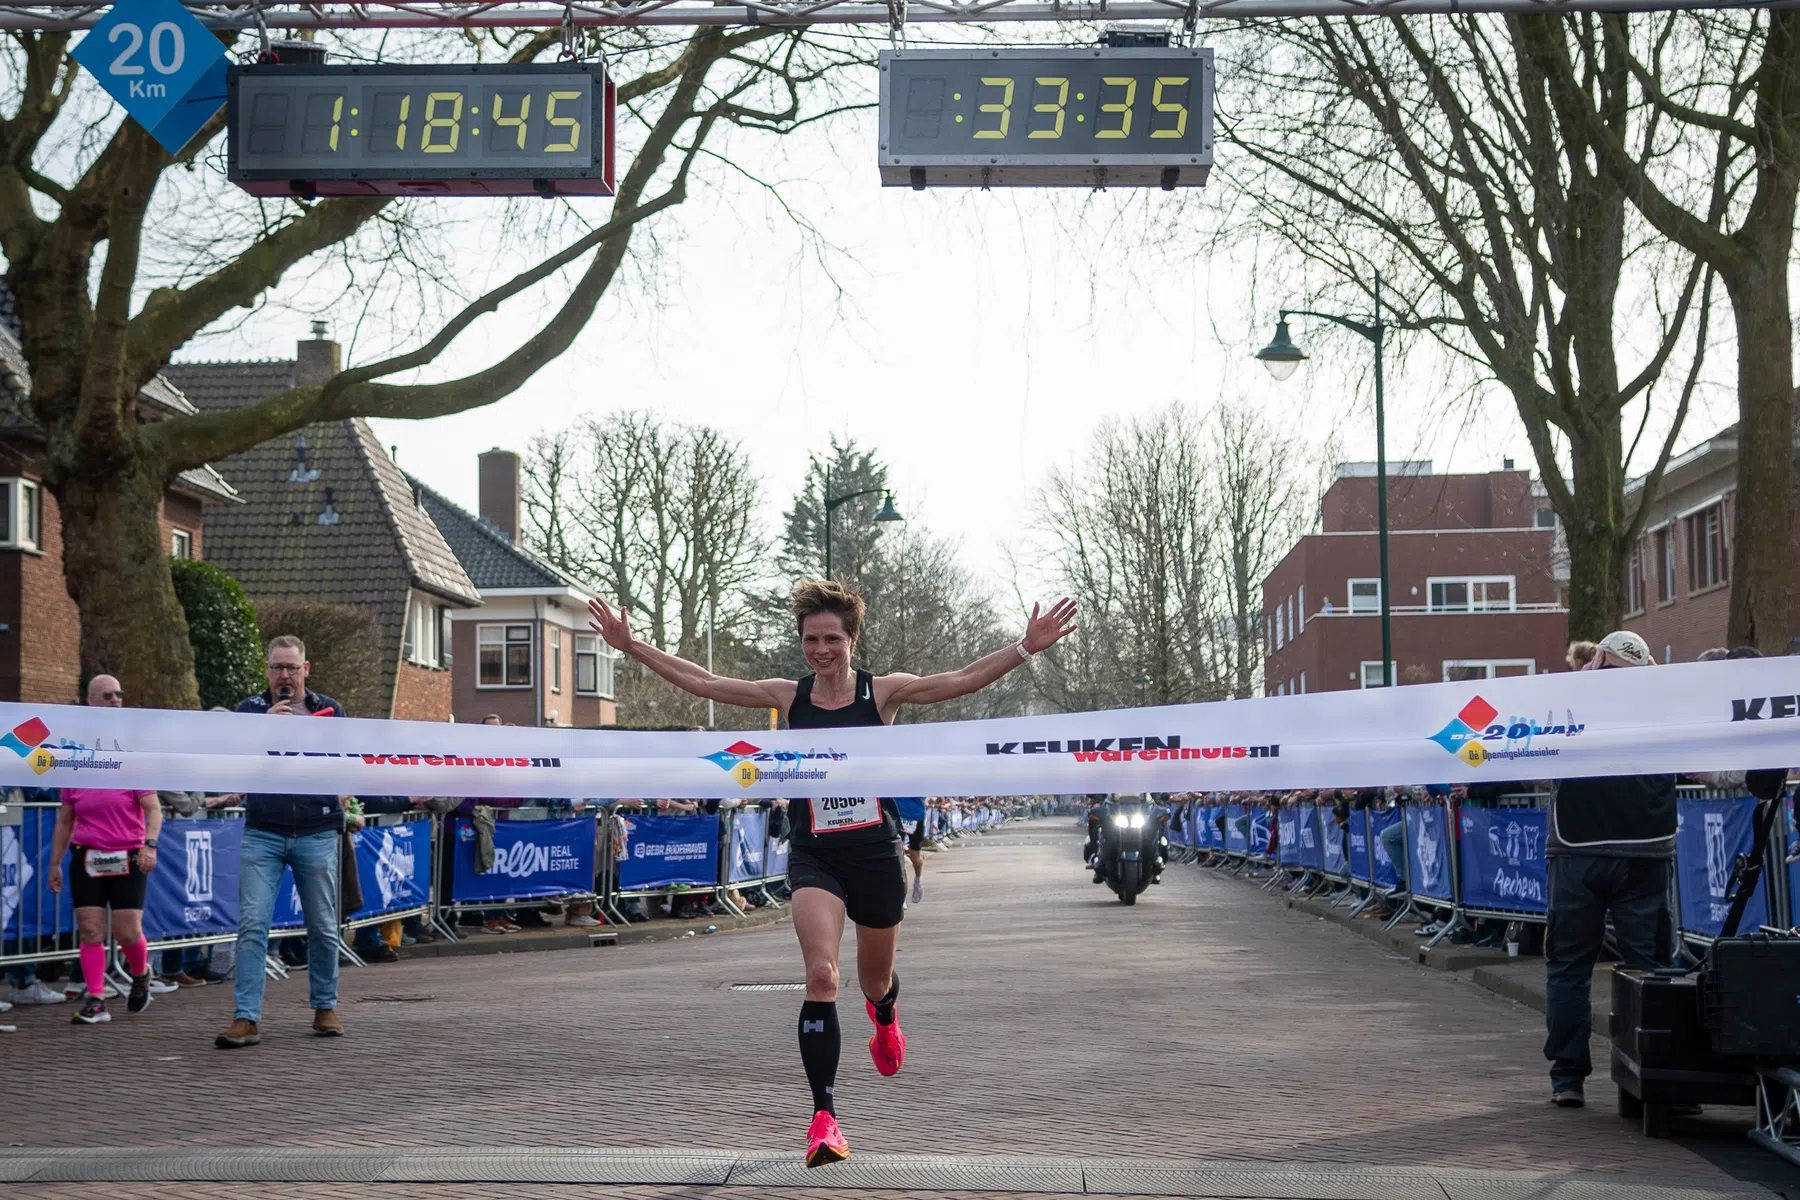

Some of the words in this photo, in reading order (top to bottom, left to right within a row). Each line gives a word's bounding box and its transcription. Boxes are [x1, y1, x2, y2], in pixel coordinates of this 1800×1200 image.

[108, 21, 186, 76] 20
[129, 80, 166, 98] Km
[328, 91, 583, 154] 1:18:45
[1730, 694, 1800, 722] KE
[1482, 746, 1560, 761] Openingsklassieker
[49, 756, 123, 771] Openingsklassieker
[754, 768, 828, 782] Openingsklassieker
[827, 817, 854, 826] KEUKEN
[551, 845, 572, 858] REAL
[551, 858, 580, 872] ESTATE
